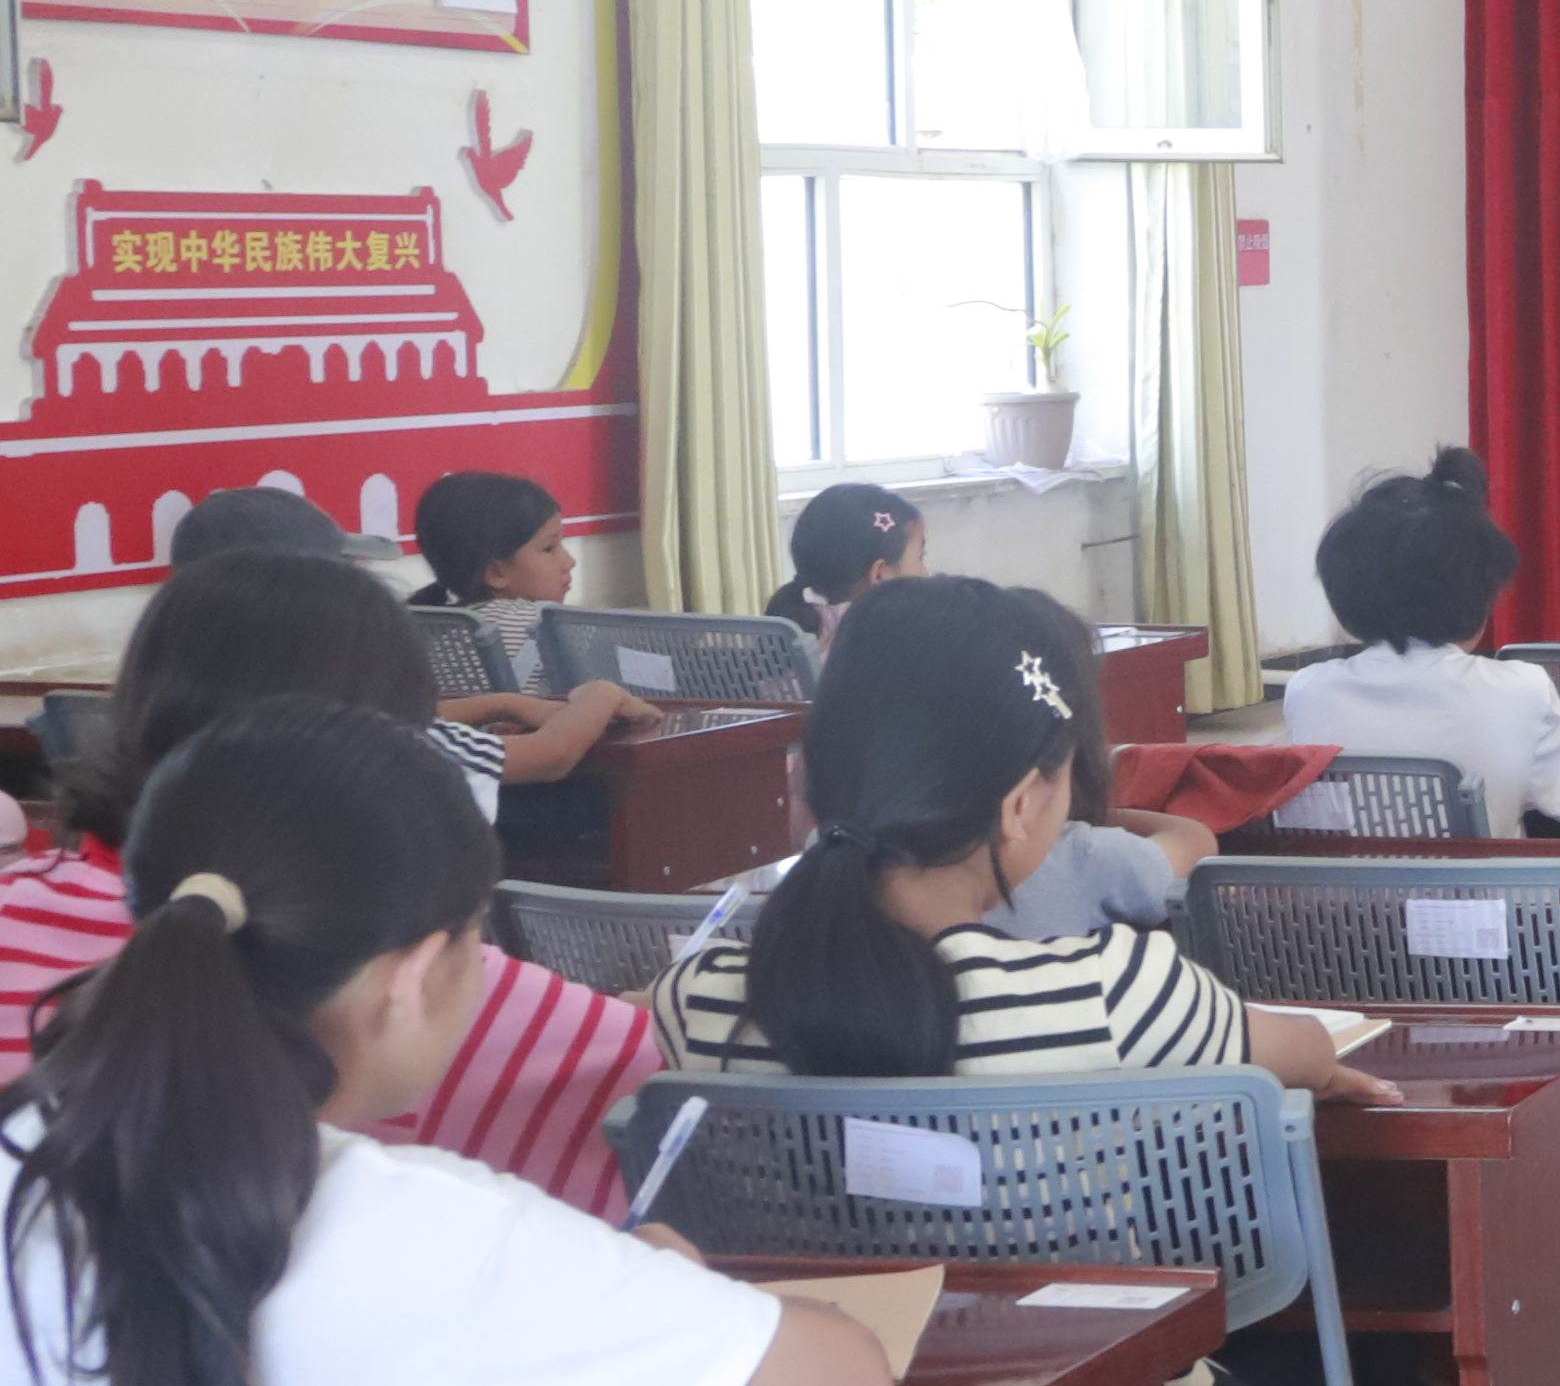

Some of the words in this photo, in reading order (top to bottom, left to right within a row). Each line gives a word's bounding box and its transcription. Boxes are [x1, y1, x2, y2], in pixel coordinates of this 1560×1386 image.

[111, 229, 421, 274] 实现中华民族伟大复兴
